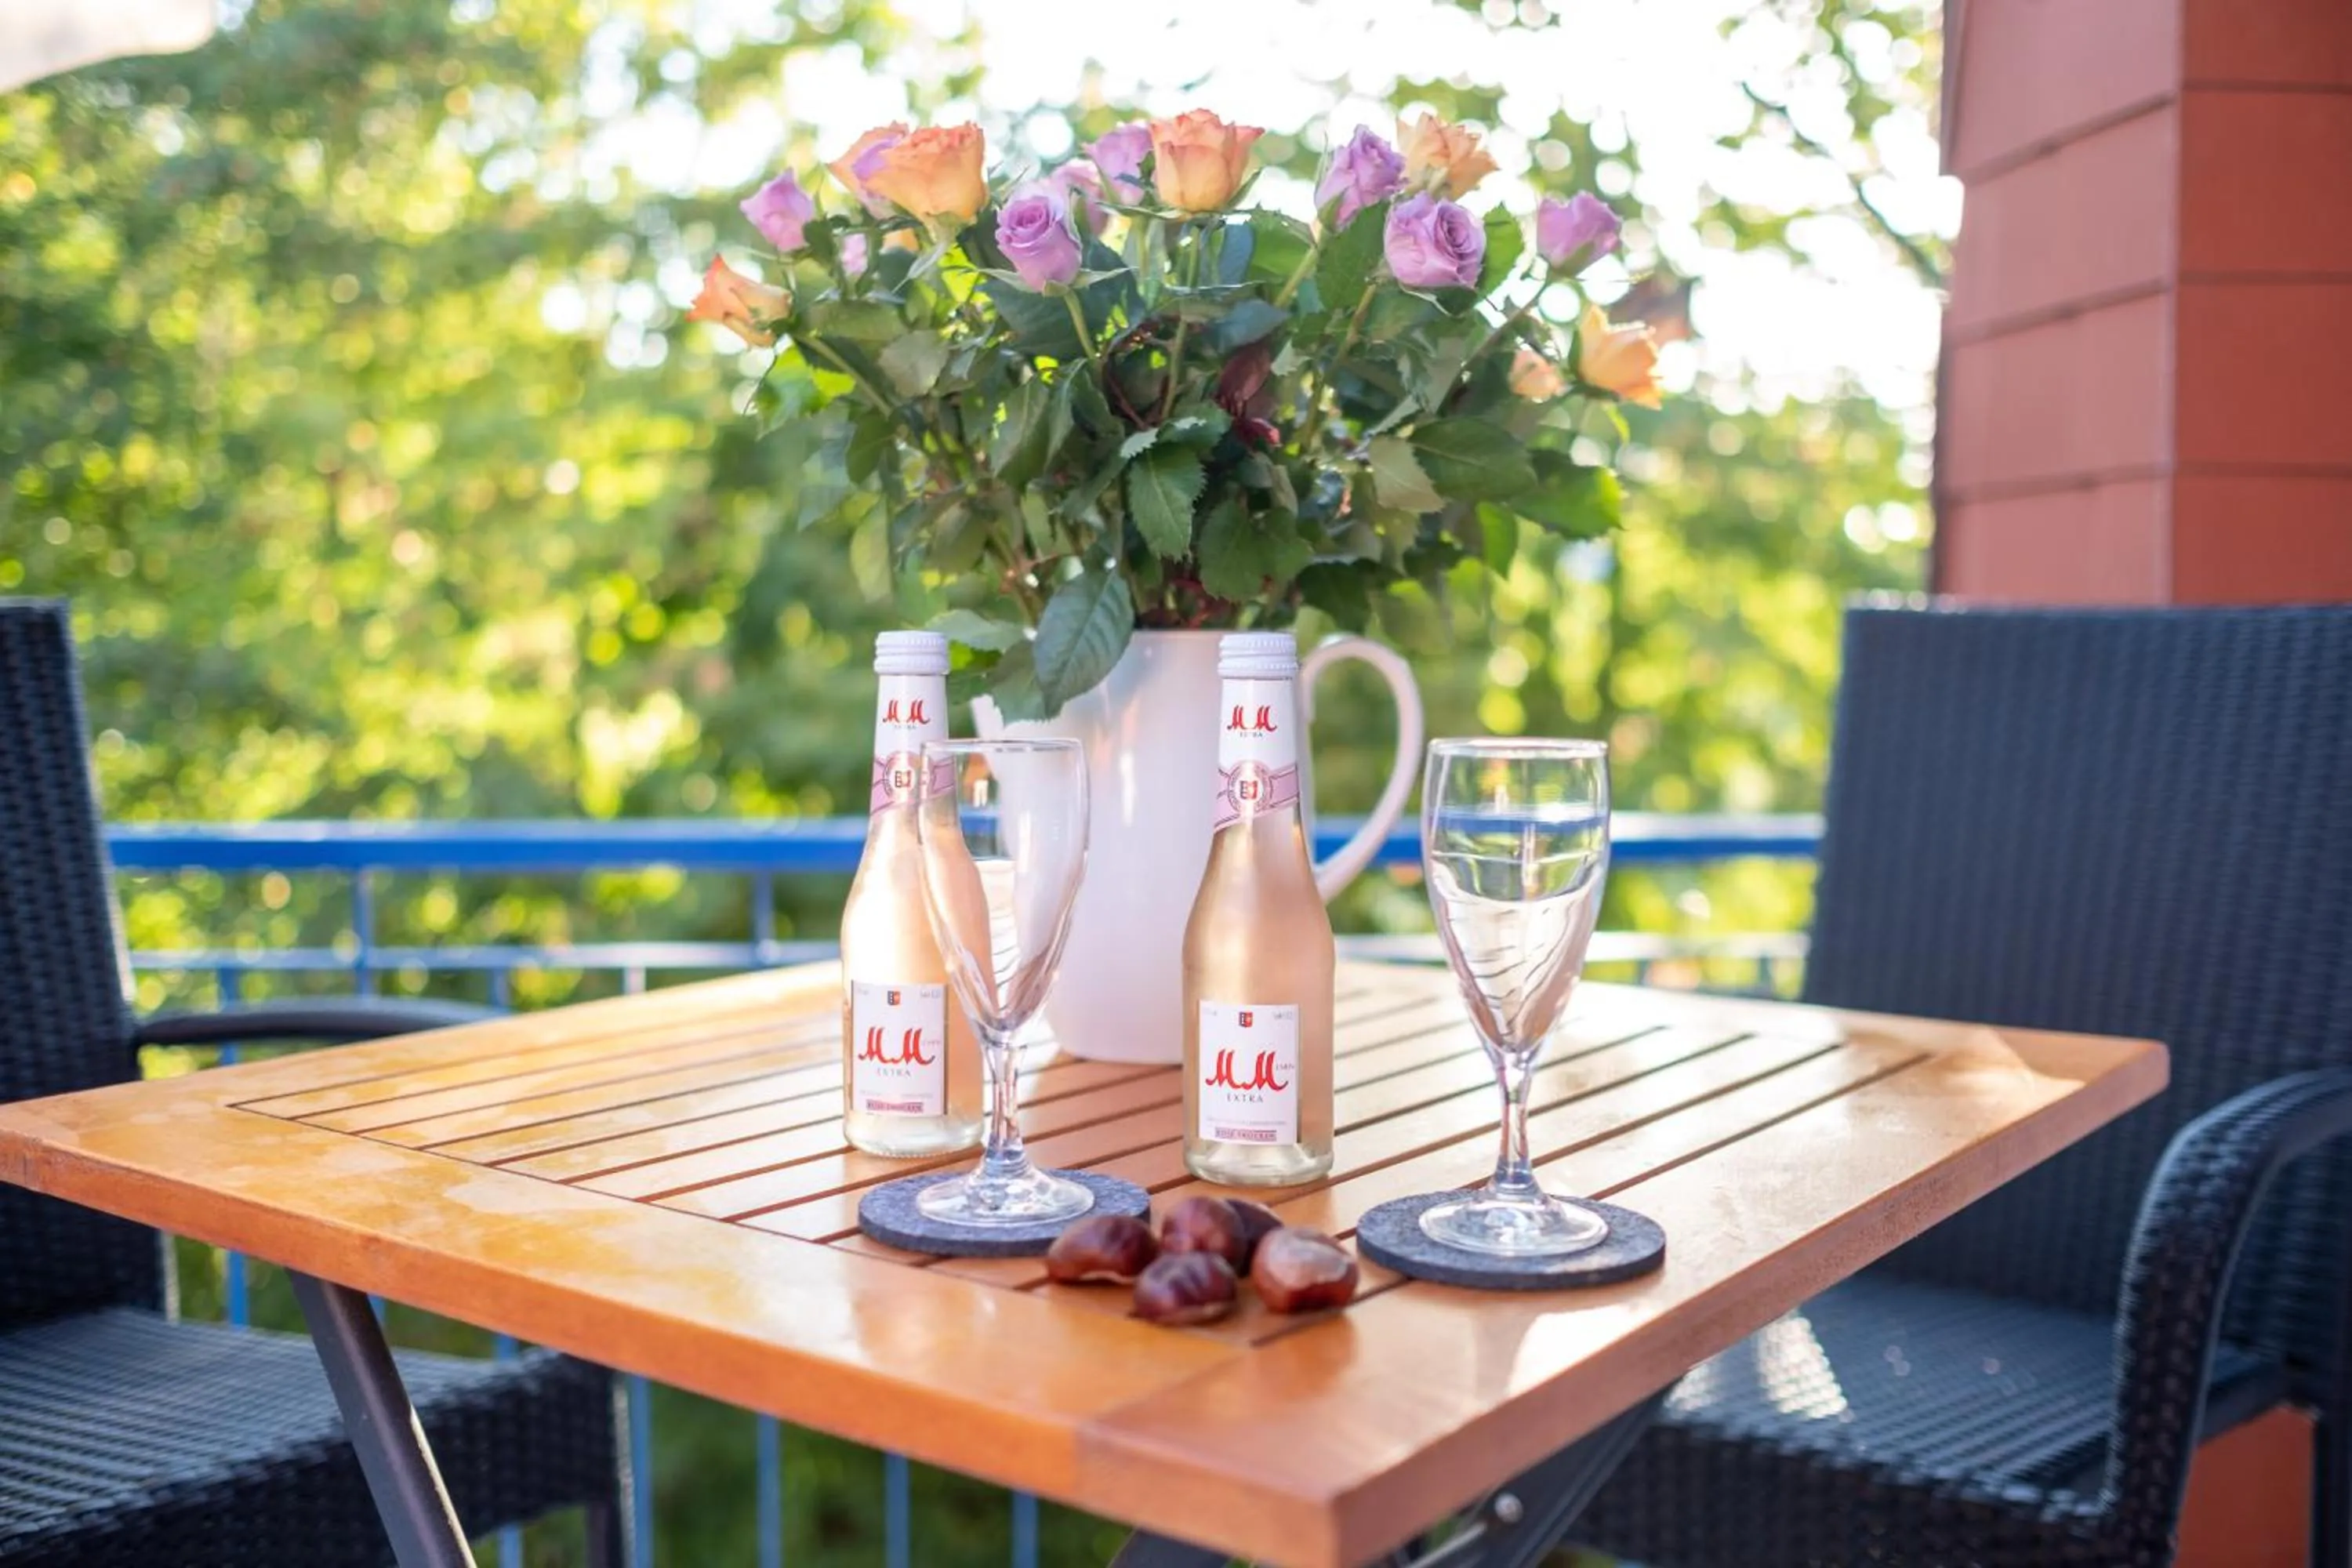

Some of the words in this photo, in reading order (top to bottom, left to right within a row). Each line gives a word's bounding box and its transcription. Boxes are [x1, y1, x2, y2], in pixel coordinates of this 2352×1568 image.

[858, 1026, 936, 1065] MM
[1205, 1048, 1288, 1091] MM
[1227, 1093, 1264, 1103] EXTRA
